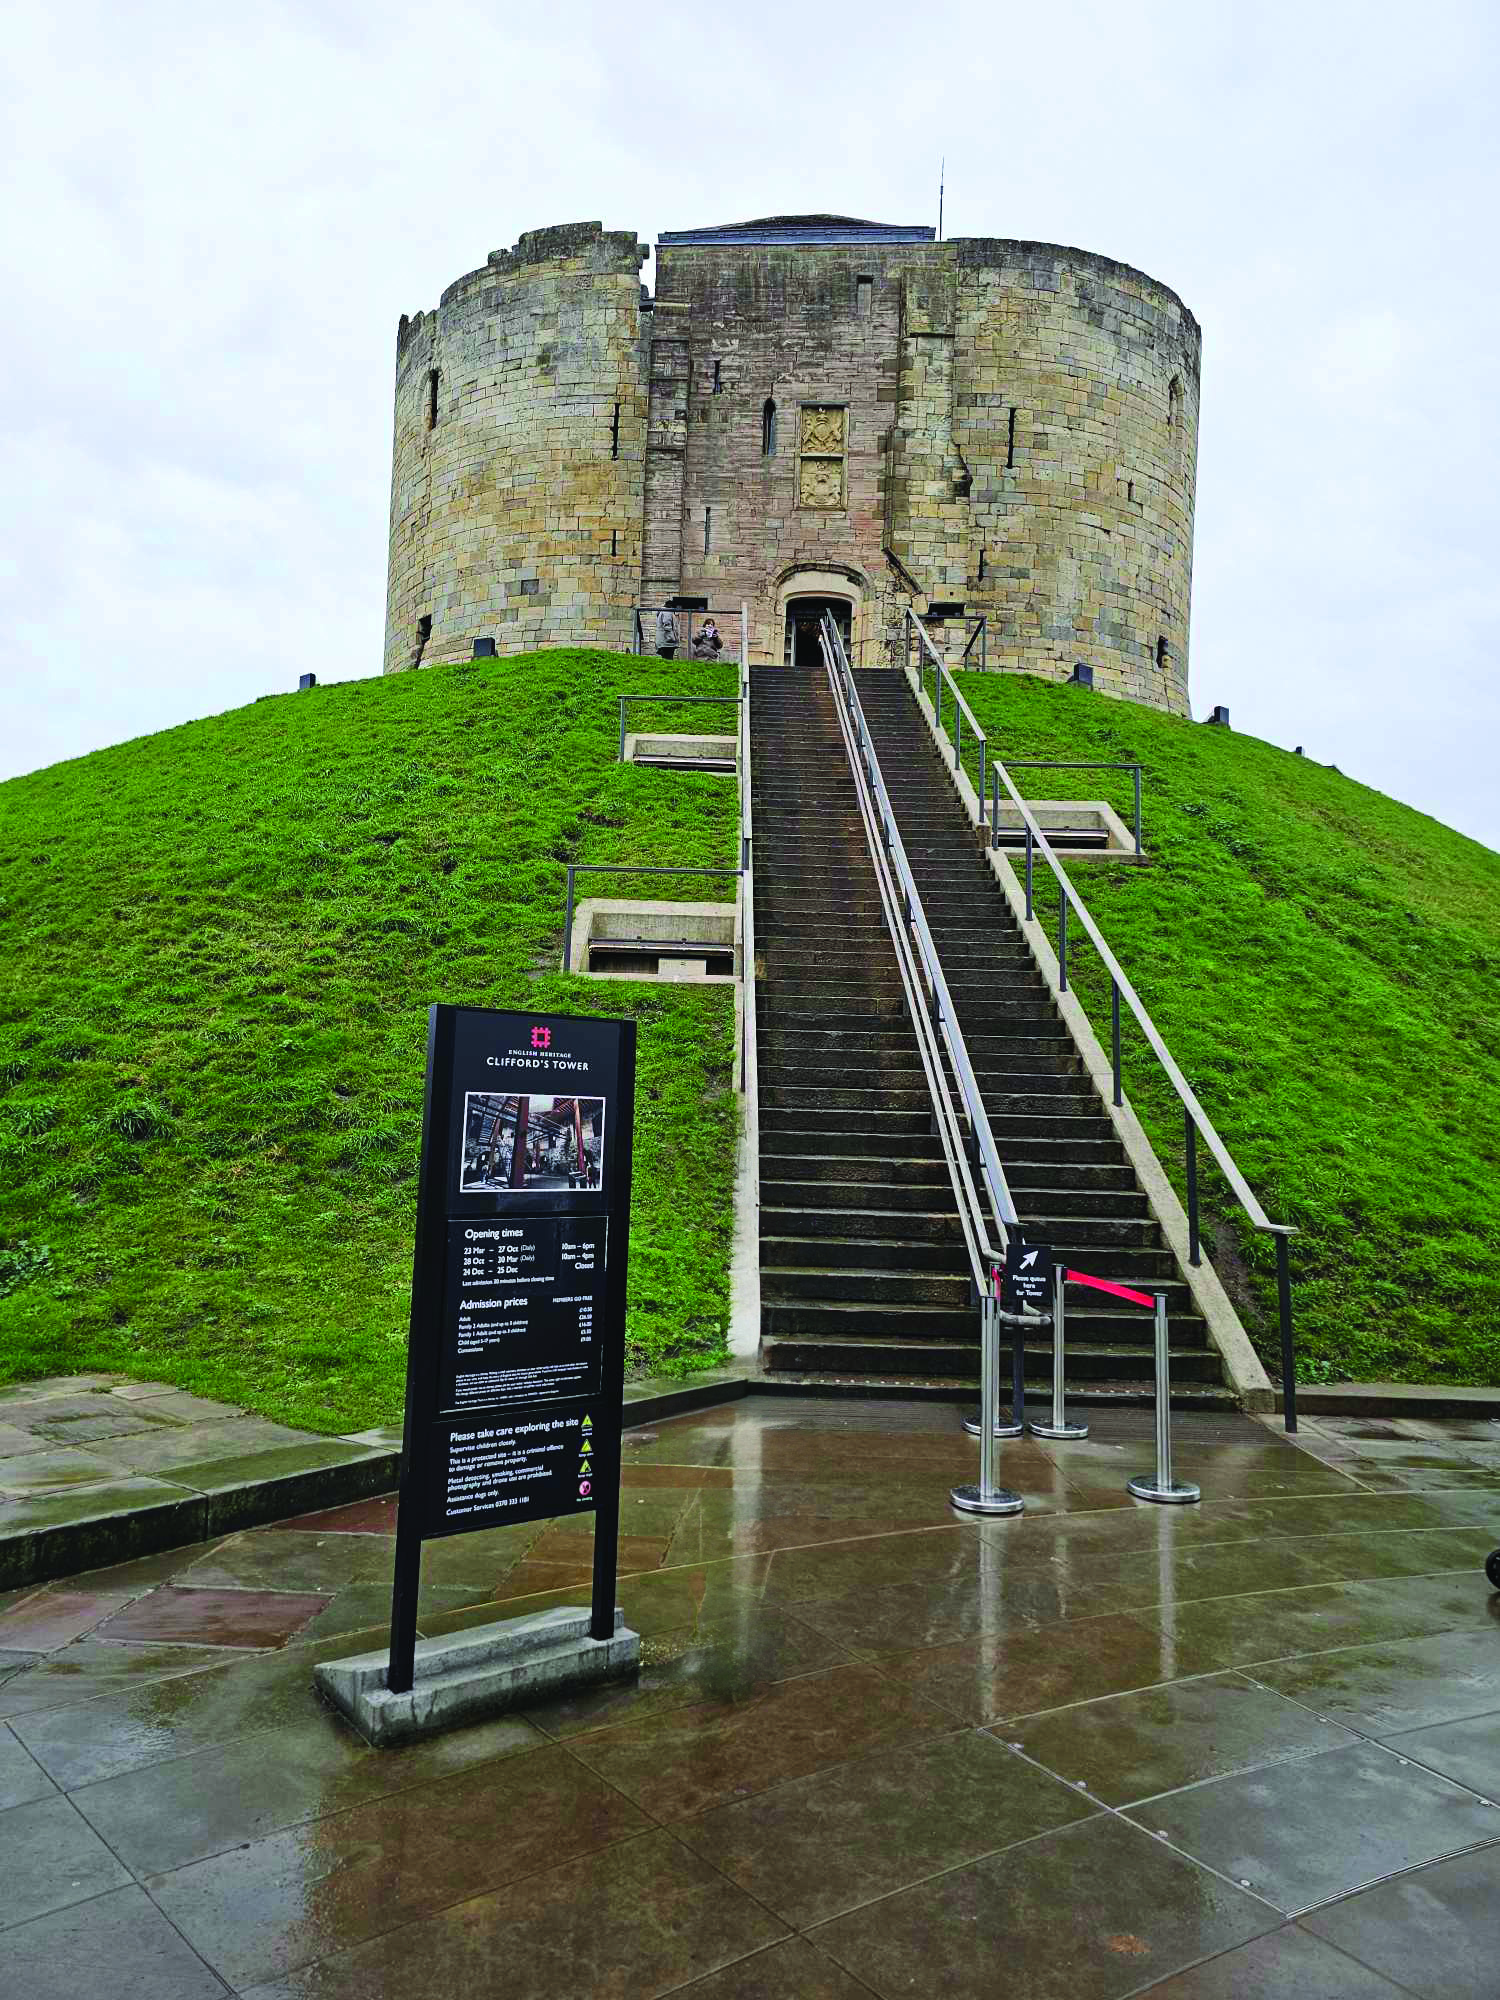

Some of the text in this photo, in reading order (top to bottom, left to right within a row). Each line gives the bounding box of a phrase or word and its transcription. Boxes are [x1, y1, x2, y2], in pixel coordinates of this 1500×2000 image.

[486, 1057, 589, 1070] CLIFFORD'S TOWER
[465, 1228, 523, 1241] Opening times
[460, 1297, 528, 1310] Admission prices
[450, 1418, 579, 1442] Please take care exploring the site
[450, 1446, 475, 1454] Supervise
[471, 1453, 497, 1463] protected
[526, 1446, 546, 1454] criminal
[515, 1464, 544, 1474] commercial
[447, 1481, 481, 1493] photography
[447, 1494, 474, 1503] Assistance
[446, 1507, 473, 1516] Customer
